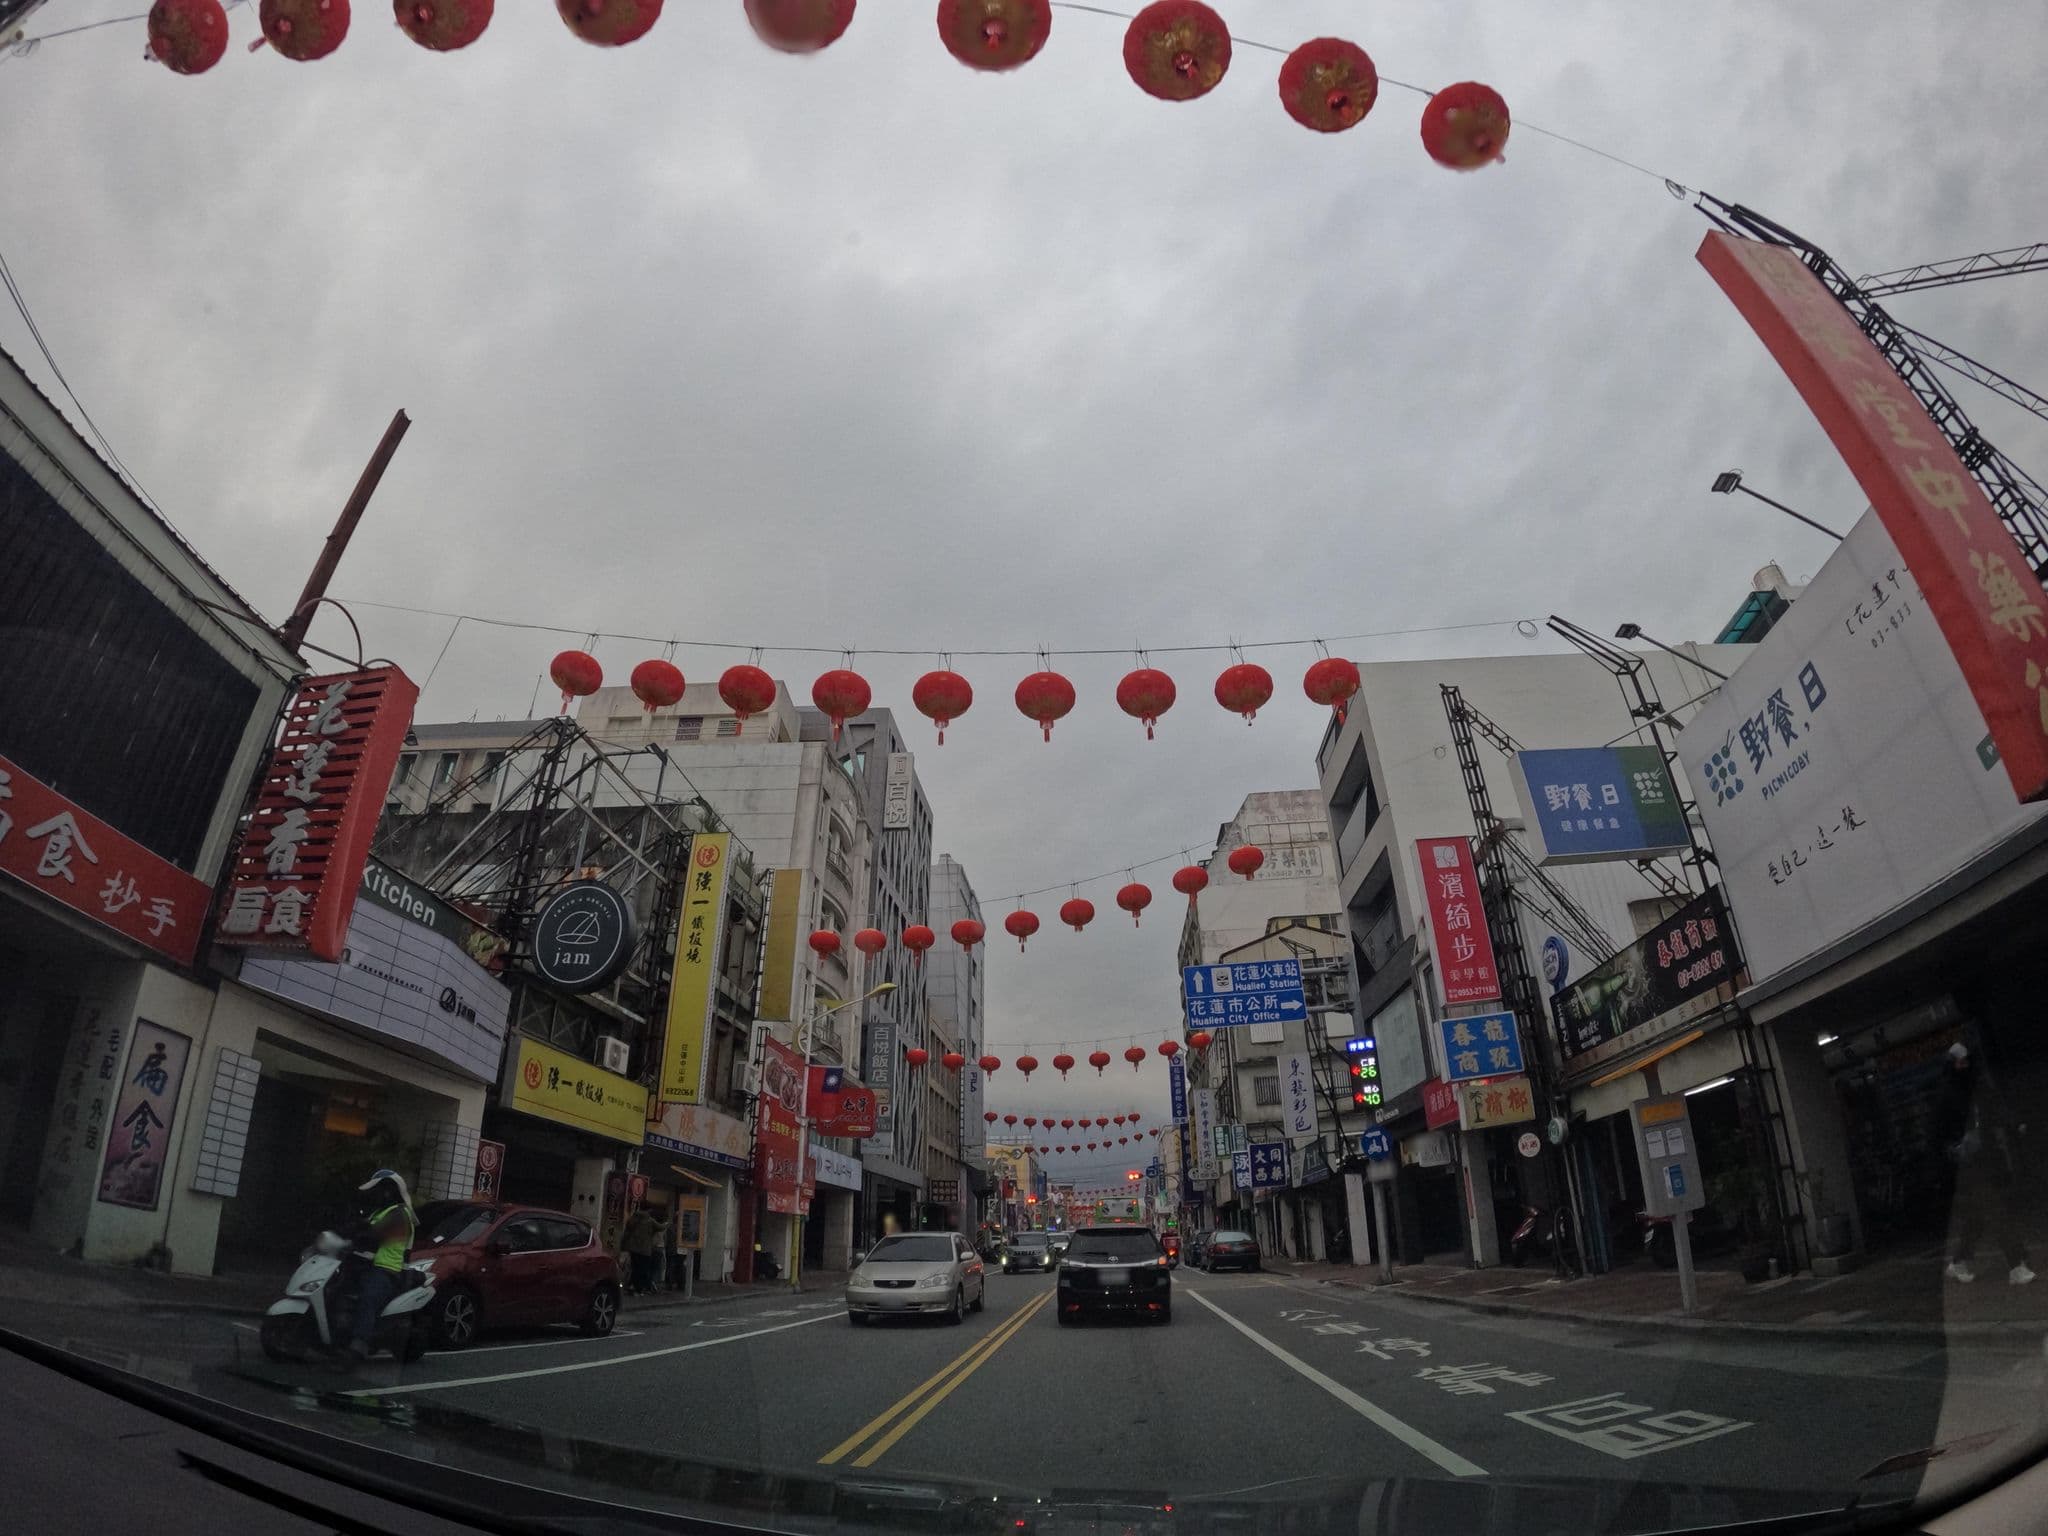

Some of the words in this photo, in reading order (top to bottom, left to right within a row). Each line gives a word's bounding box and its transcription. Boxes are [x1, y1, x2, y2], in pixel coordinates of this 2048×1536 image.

[99, 869, 177, 938] 抄手
[221, 886, 312, 937] 扁食
[553, 947, 592, 968] jam
[1233, 961, 1298, 981] 花蓮火車站
[1235, 980, 1266, 992] Hualien
[1269, 978, 1300, 989] Station
[1190, 995, 1279, 1016] 花蓮市公所
[1191, 1015, 1225, 1026] Hualien
[1229, 1013, 1250, 1025] City
[1253, 1010, 1281, 1020] Office
[871, 1026, 890, 1083] 百悅飯店
[970, 1071, 979, 1094] FILA
[121, 1041, 172, 1151] 扁食
